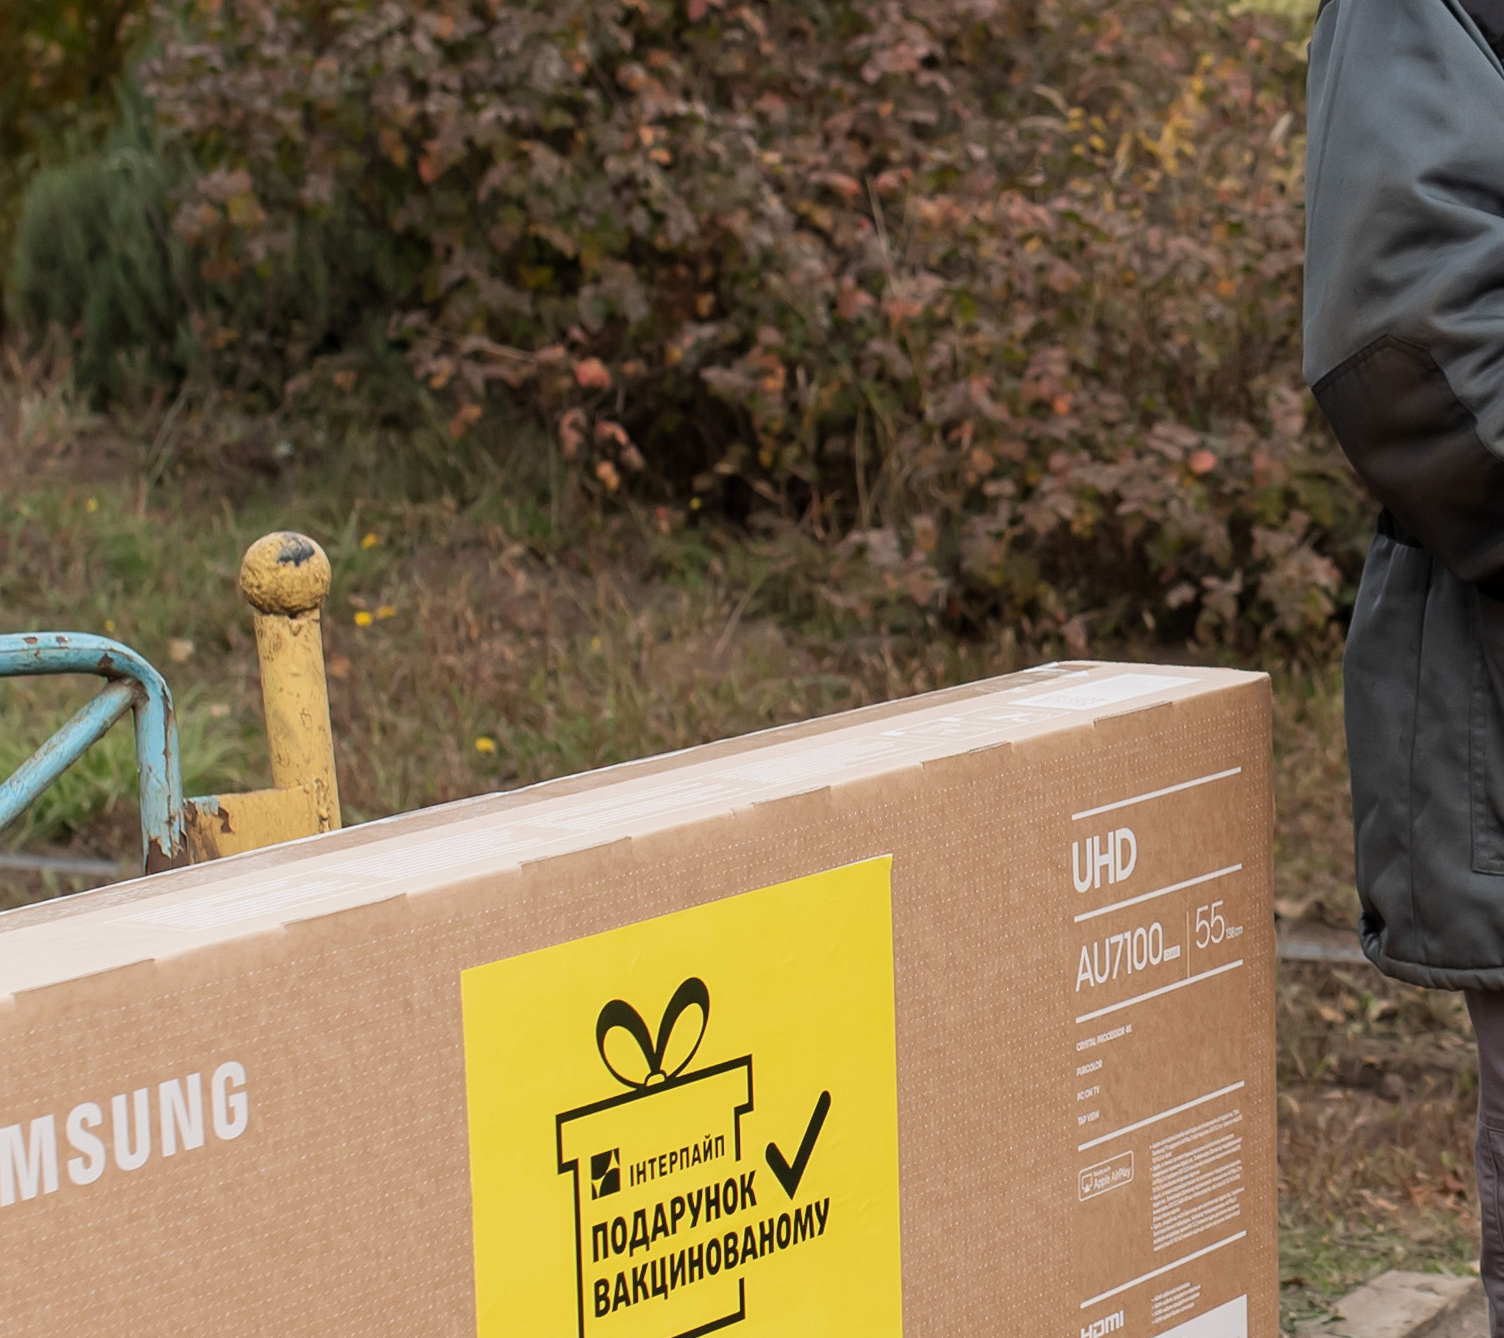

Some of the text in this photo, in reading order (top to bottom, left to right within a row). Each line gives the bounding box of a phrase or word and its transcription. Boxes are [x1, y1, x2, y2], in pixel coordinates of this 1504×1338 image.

[1071, 827, 1138, 893] UHD
[1075, 922, 1163, 992] AU7100
[1195, 899, 1225, 949] 55
[630, 1133, 726, 1187] ІНТЕРПАЙП
[592, 1170, 757, 1263] ПОДАРУНОК
[593, 1197, 831, 1318] ВАКЦИНОВАНОМУ
